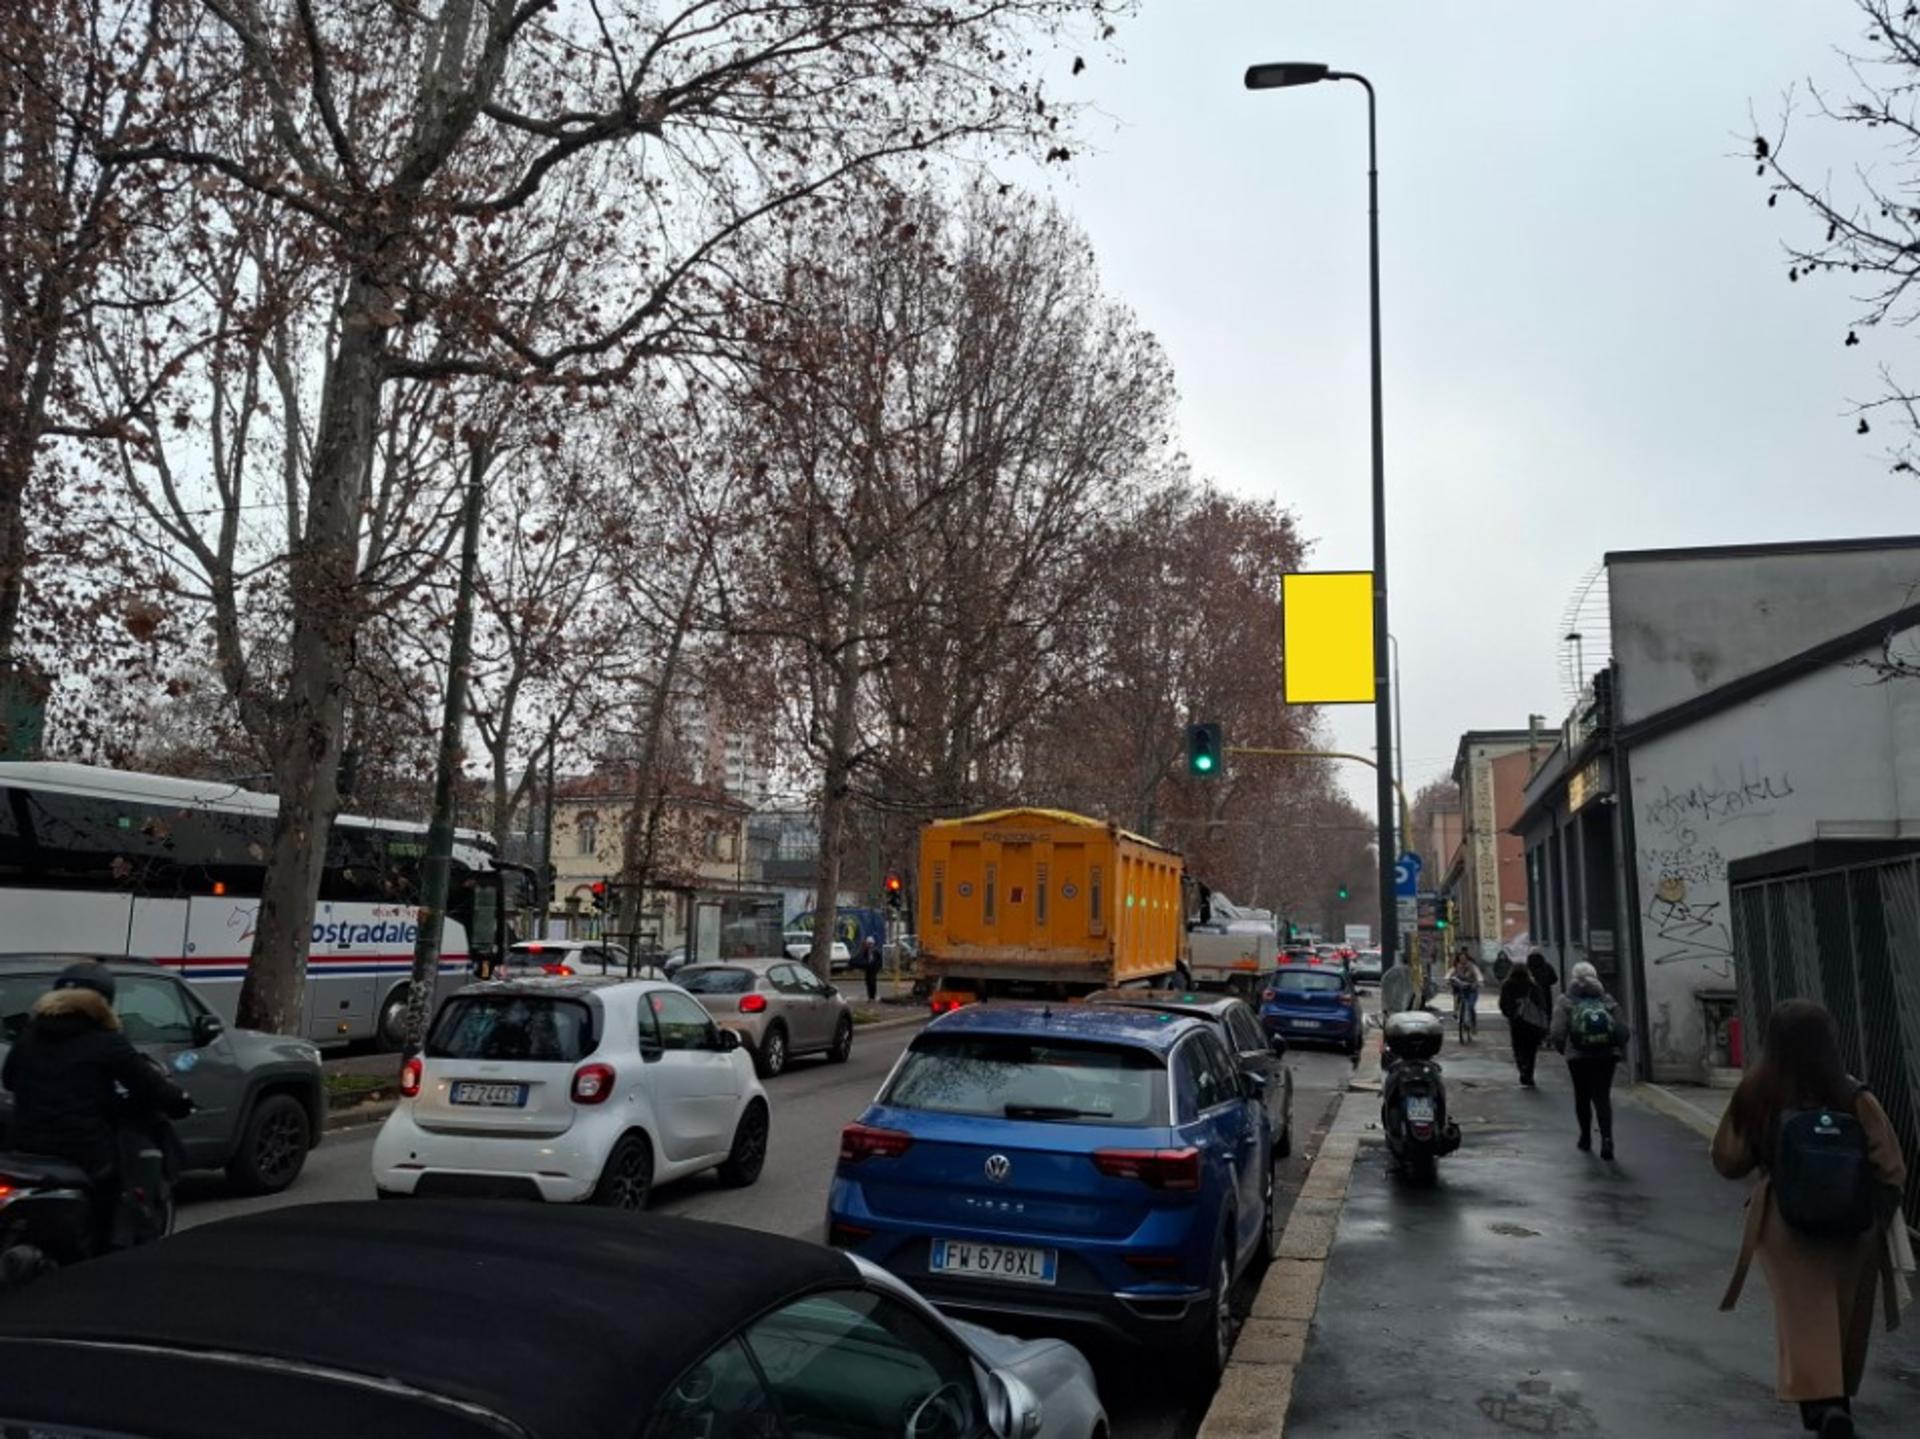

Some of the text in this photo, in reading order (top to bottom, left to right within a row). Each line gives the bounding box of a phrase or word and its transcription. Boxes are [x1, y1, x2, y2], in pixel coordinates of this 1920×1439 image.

[311, 920, 418, 944] ostradale
[946, 1244, 1039, 1276] FW 678XL
